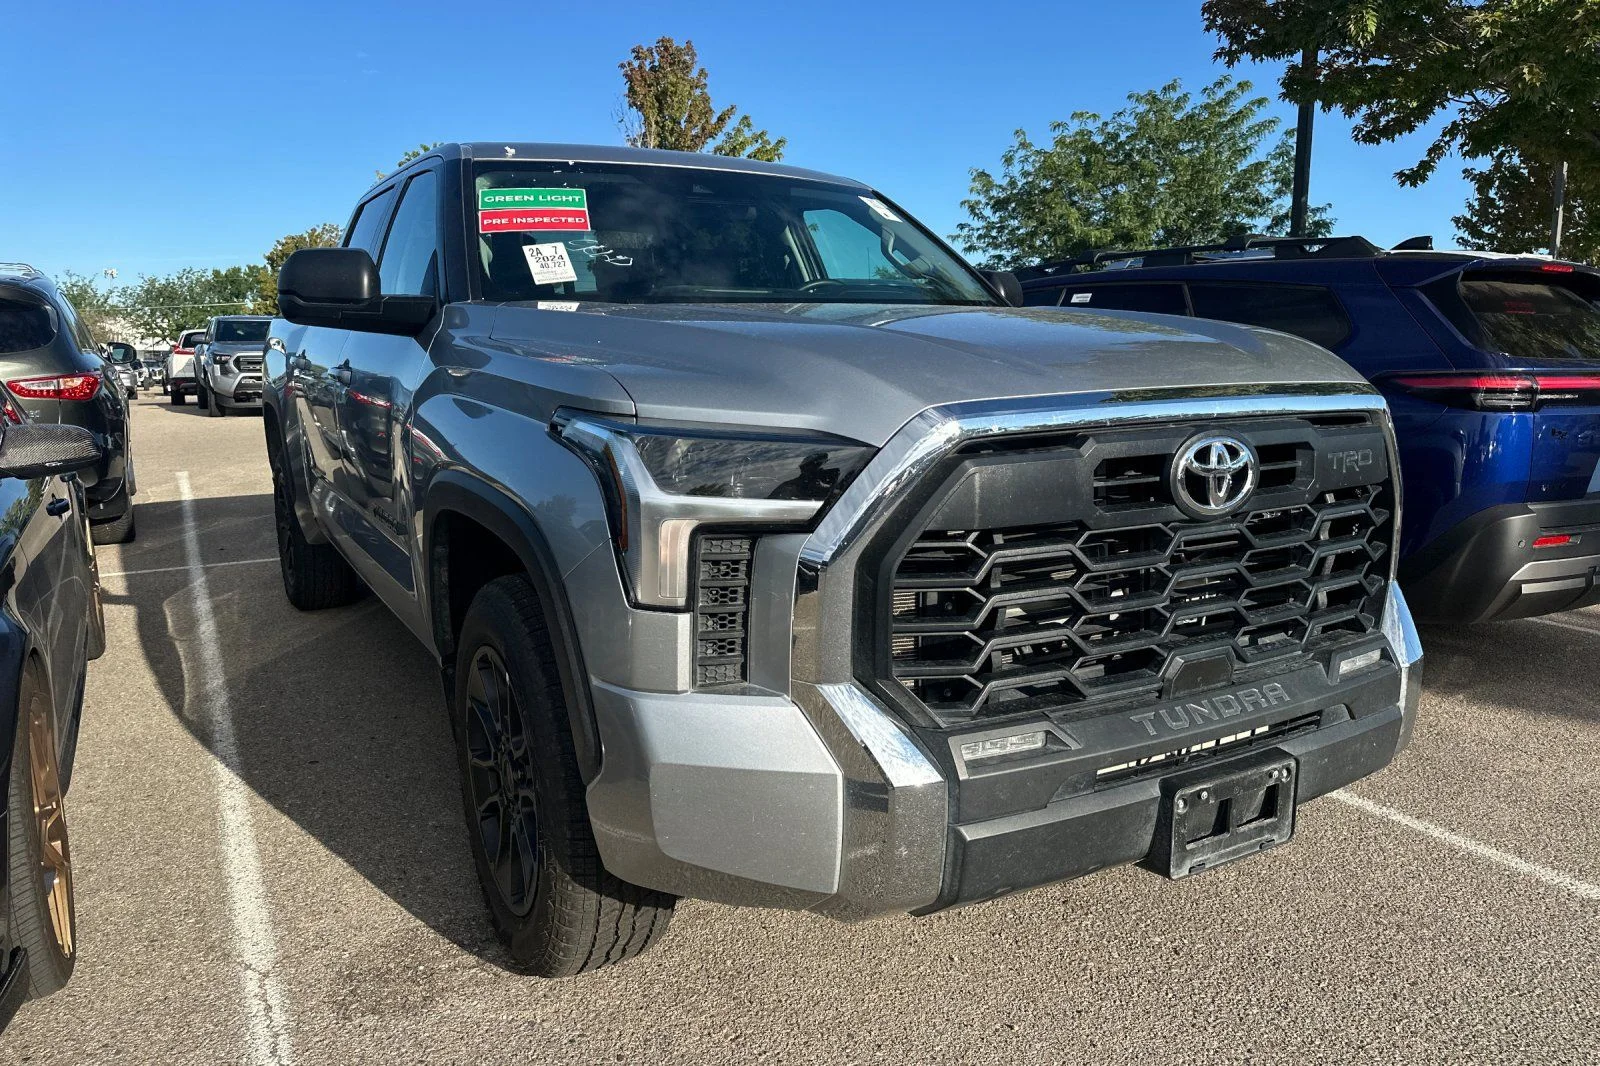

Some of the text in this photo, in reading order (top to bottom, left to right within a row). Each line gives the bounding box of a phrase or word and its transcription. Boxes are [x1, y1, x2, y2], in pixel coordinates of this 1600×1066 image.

[484, 195, 534, 203] GREEN
[528, 245, 558, 257] 2A 7
[534, 254, 564, 263] 2024
[1328, 449, 1372, 473] TRD
[1129, 682, 1291, 736] TUNDRA
